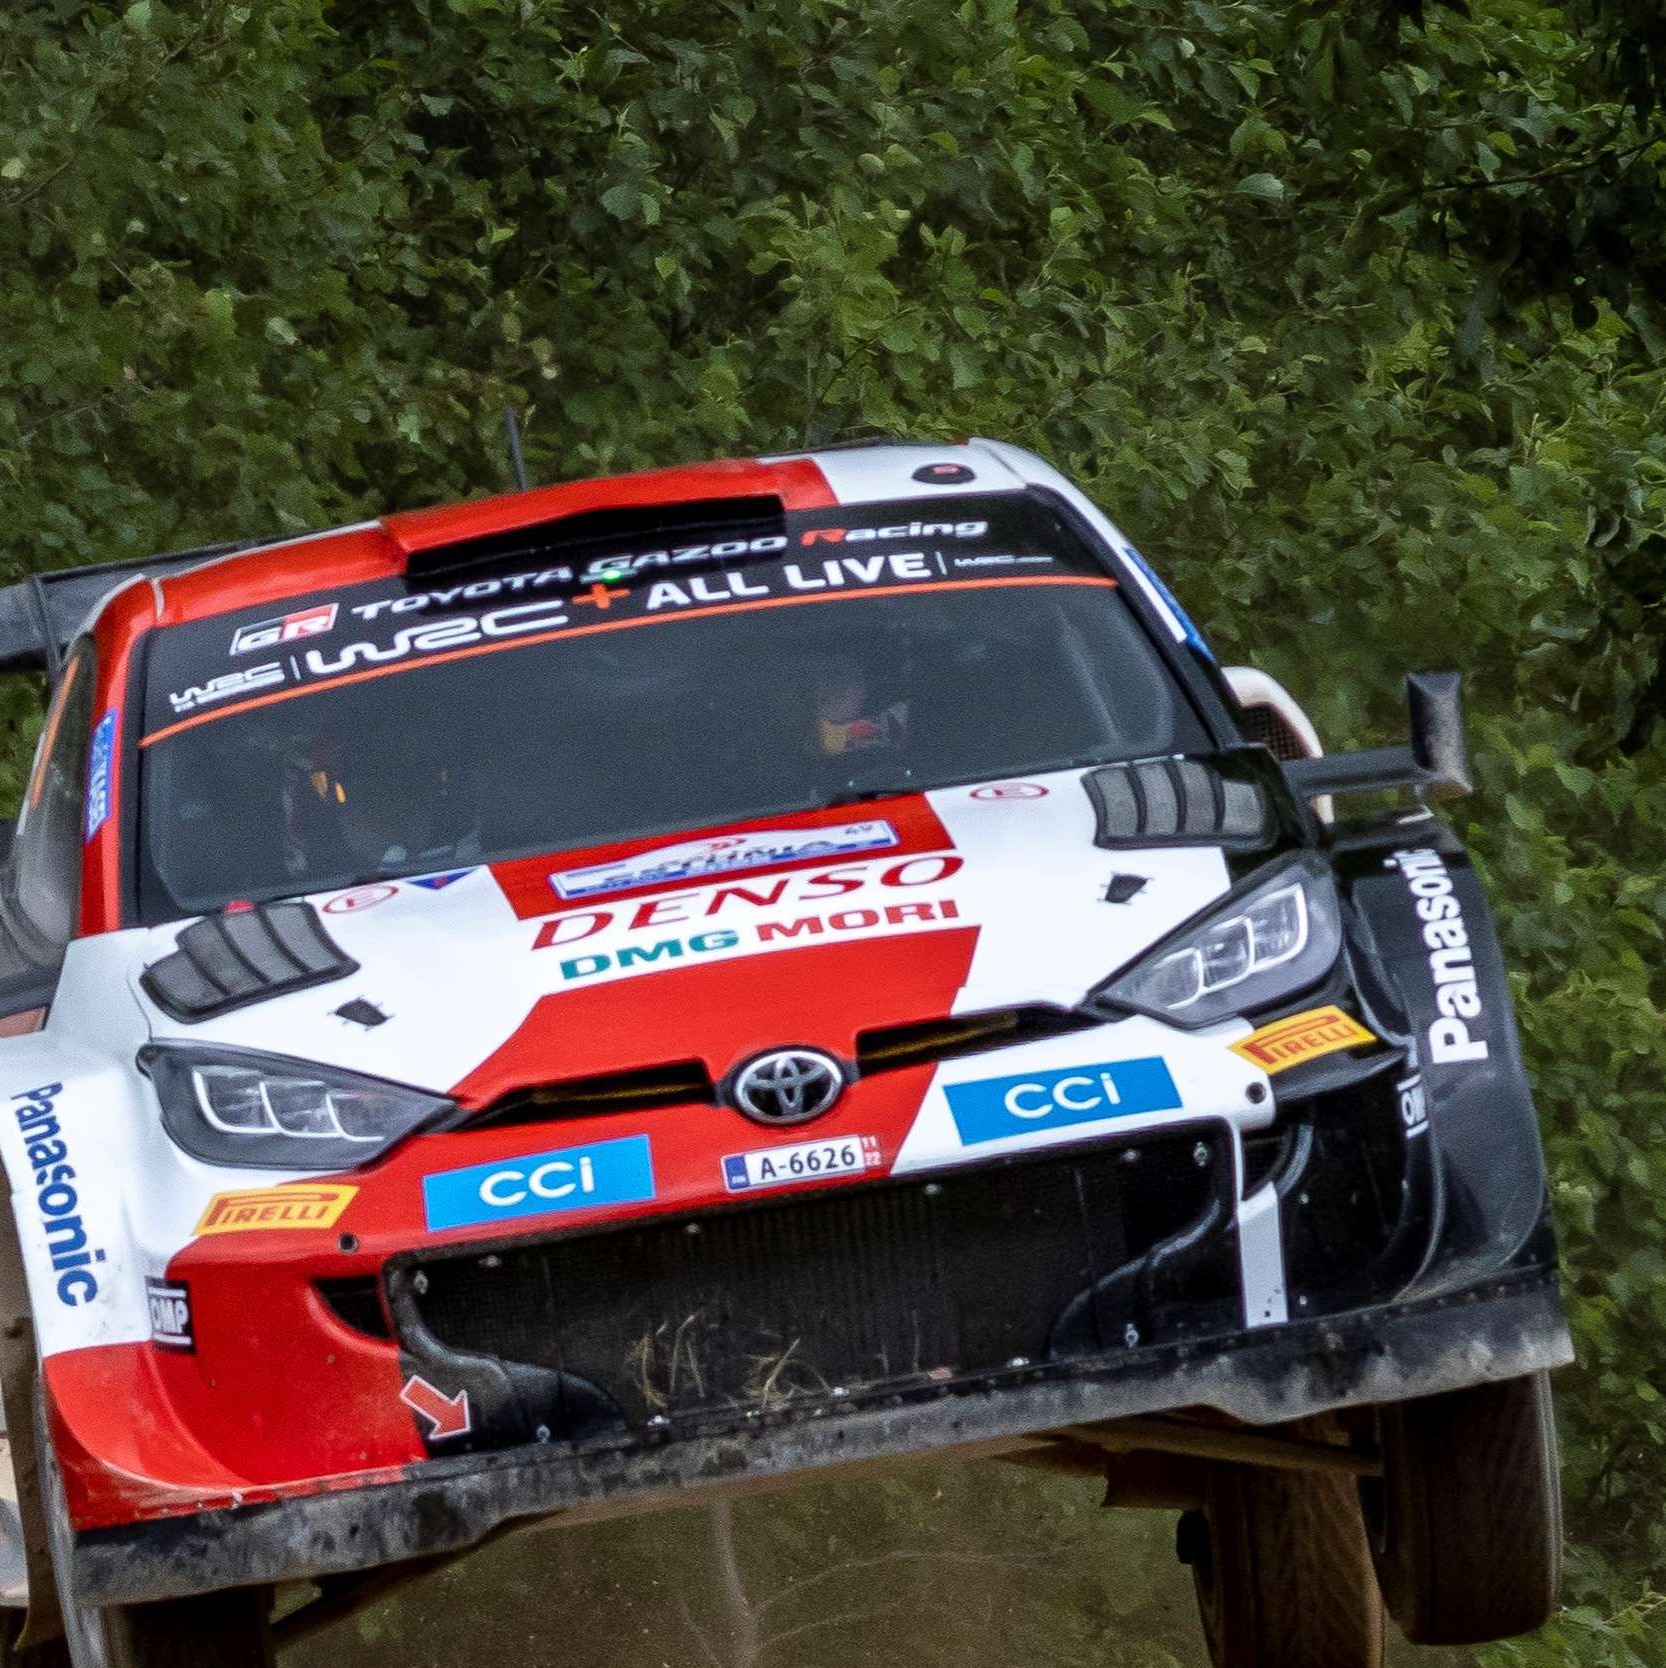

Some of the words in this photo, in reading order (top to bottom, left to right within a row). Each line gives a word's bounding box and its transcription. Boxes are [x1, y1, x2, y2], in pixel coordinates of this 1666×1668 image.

[351, 565, 574, 620] TOYOTA
[588, 534, 789, 574] GAZOO
[799, 520, 989, 547] Racing
[646, 570, 769, 610] ALL
[782, 552, 933, 592] LIVE
[236, 613, 331, 653] GR
[530, 855, 966, 951] DENSO
[558, 929, 742, 981] DMG
[755, 899, 960, 942] MORI
[1242, 1013, 1359, 1065] PIRELLI
[759, 1145, 856, 1181] A-6626
[10, 1081, 107, 1307] Panasonic
[204, 1193, 340, 1229] PIRELLI
